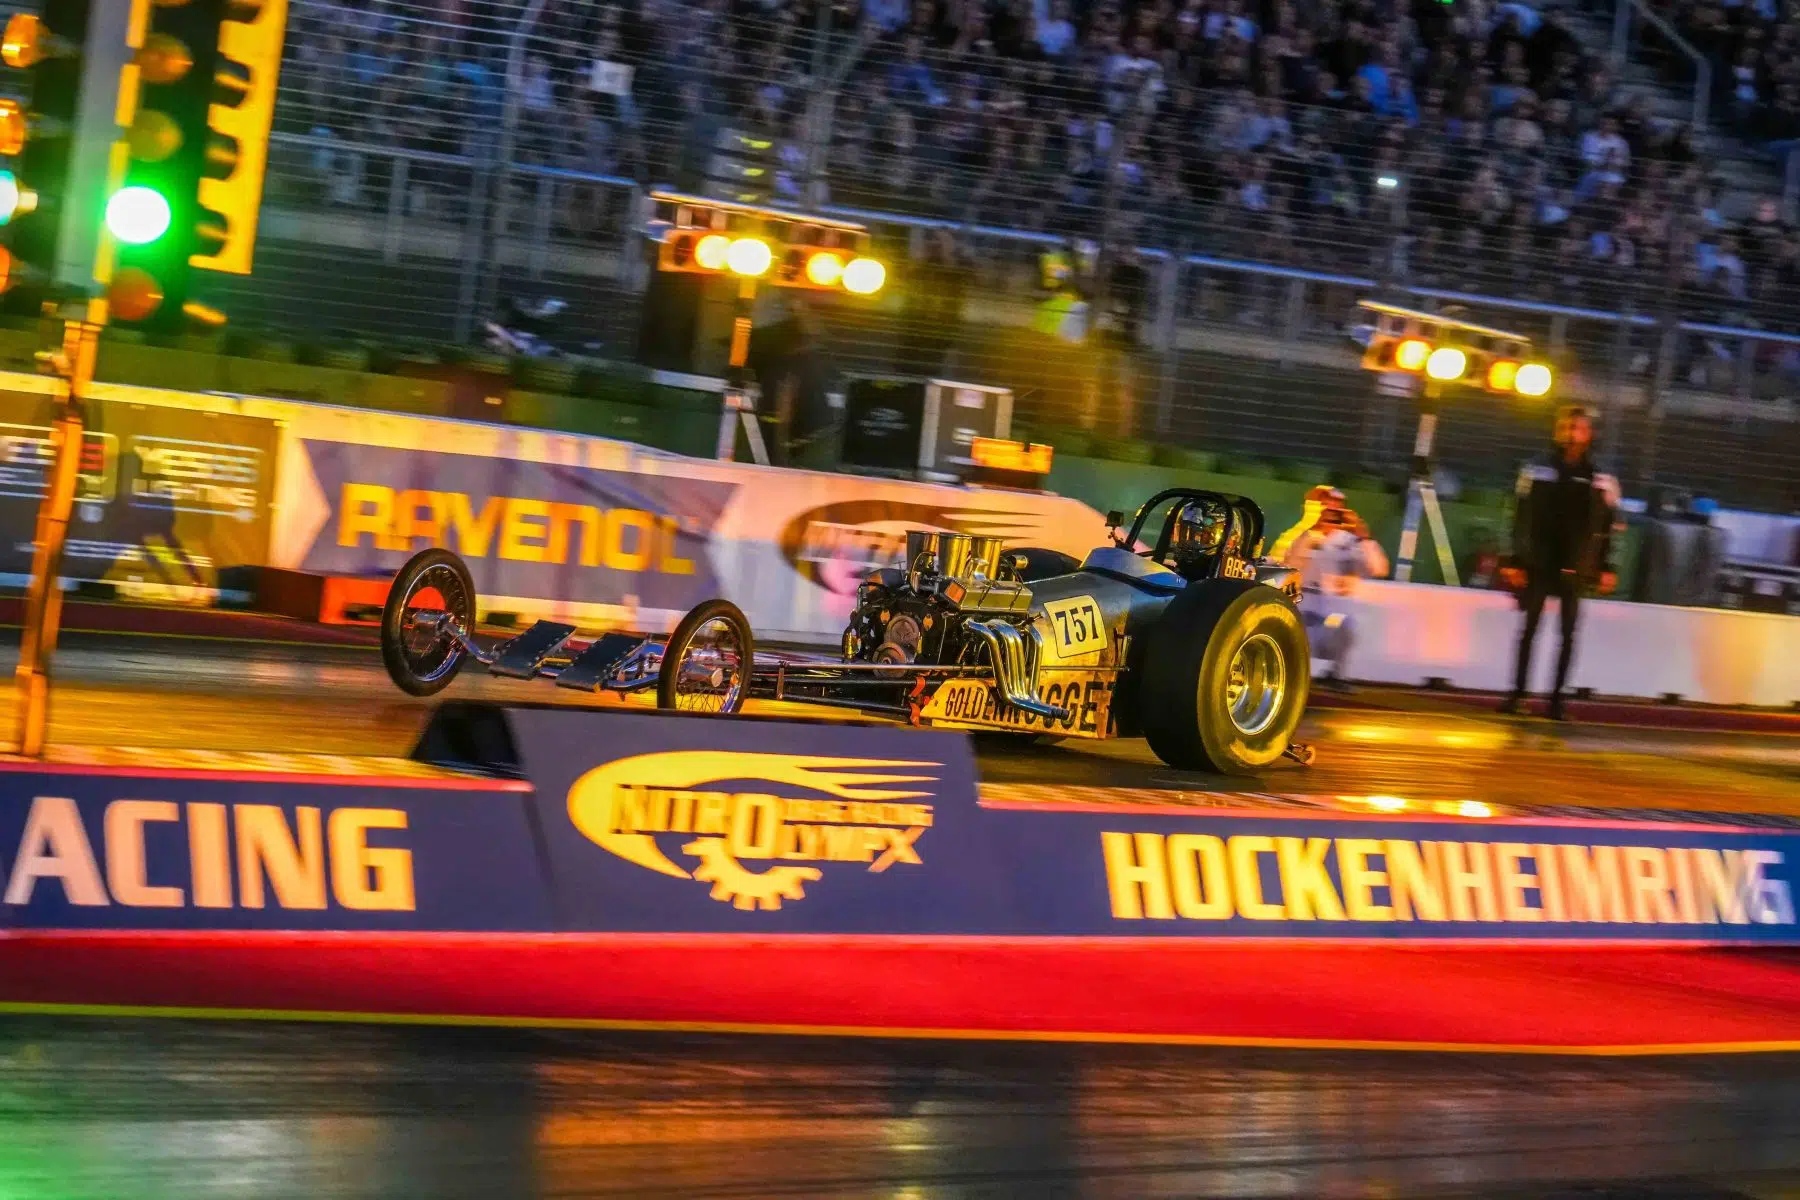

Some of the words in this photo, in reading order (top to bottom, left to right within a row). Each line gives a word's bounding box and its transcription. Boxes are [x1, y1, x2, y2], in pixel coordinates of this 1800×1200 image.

[337, 482, 695, 575] RAVENOL
[1055, 605, 1099, 645] 757
[4, 796, 416, 911] ACING
[1101, 832, 1796, 925] HOCKENHEIMRING
